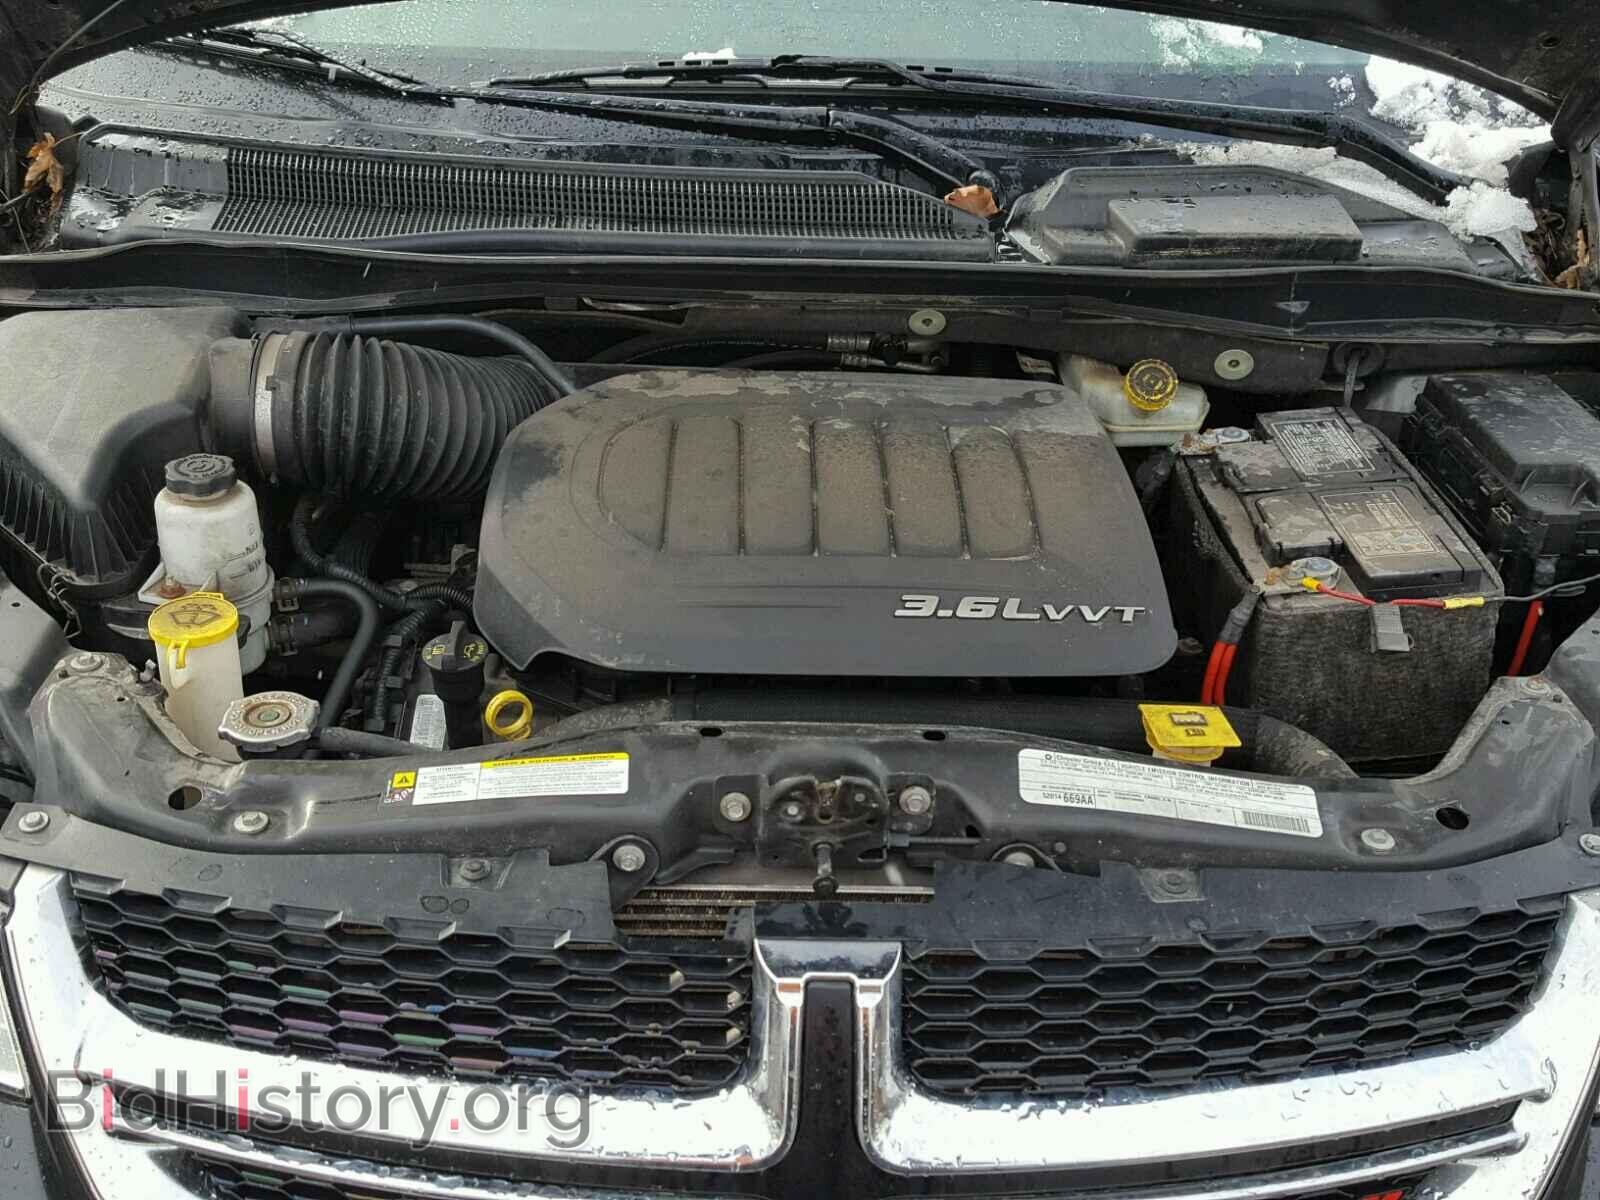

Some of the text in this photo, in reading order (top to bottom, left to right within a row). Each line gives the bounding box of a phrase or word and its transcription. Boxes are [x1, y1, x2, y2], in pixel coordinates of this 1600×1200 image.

[894, 594, 1146, 623] 3.6L VVT
[1063, 792, 1094, 805] 669AA
